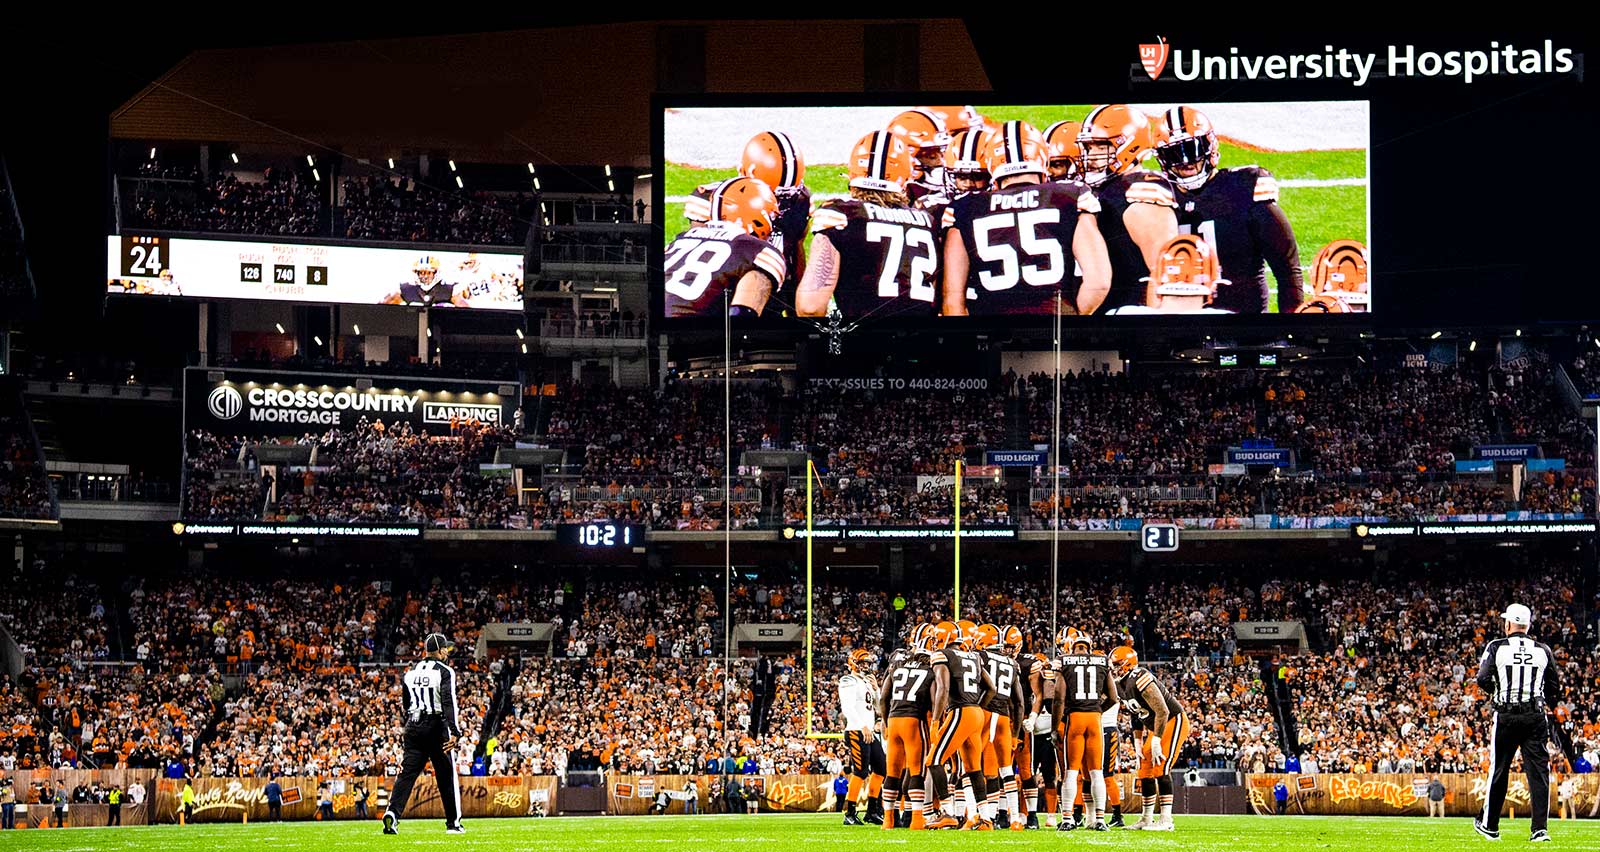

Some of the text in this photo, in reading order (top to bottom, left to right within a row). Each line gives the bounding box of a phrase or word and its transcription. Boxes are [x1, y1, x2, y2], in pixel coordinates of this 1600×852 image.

[1141, 48, 1155, 57] UH
[1173, 40, 1574, 86] University Hospitals
[973, 208, 1065, 291] 55
[130, 246, 161, 274] 24
[664, 239, 731, 300] 78
[866, 222, 937, 302] 72
[276, 268, 293, 281] 740
[313, 270, 321, 282] 8
[888, 378, 905, 389] TO
[909, 378, 988, 389] 440-824-6000
[248, 388, 419, 413] CROSSCOUNTRY
[250, 407, 341, 425] MORTGAGE
[427, 405, 499, 423] LANDING
[994, 454, 1040, 462] BUD LIGHT
[1235, 452, 1281, 460] BUD LIGHT
[1481, 448, 1528, 457] BUD LIGHT
[276, 527, 318, 535] DEFENDERS
[387, 528, 419, 536] BROWNS
[579, 525, 630, 545] 10:21
[1147, 527, 1174, 548] 21
[1062, 656, 1107, 666] PEOPLES-JONES
[1513, 653, 1532, 665] 52
[413, 676, 430, 687] 49
[892, 668, 928, 701] 27
[961, 659, 977, 693] 2
[988, 659, 1014, 697] 12
[1074, 666, 1098, 700] 11
[460, 785, 488, 800] AND
[767, 780, 812, 810] CLE
[1330, 776, 1419, 808] BROWNS
